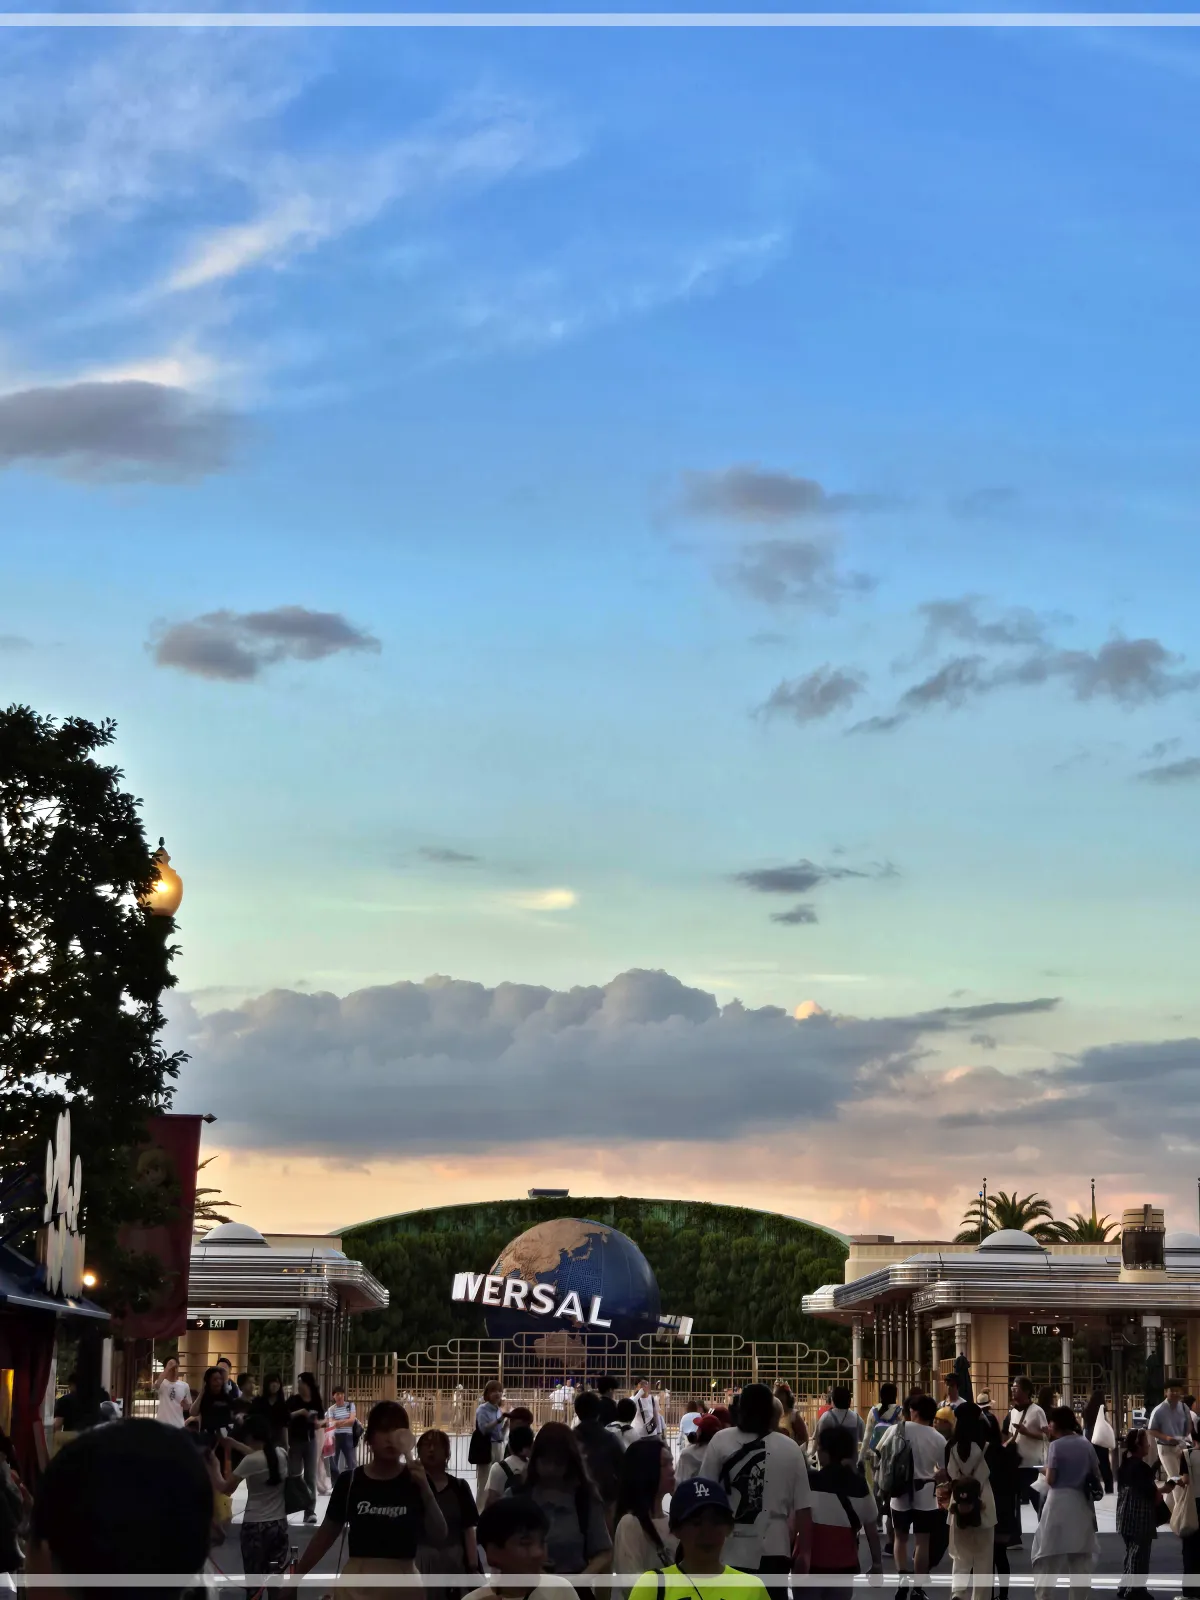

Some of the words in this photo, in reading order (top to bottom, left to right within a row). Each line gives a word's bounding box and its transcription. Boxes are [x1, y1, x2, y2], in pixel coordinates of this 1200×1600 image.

[209, 1319, 226, 1328] EXIT
[1031, 1325, 1048, 1335] EXIT
[693, 1481, 711, 1497] LA
